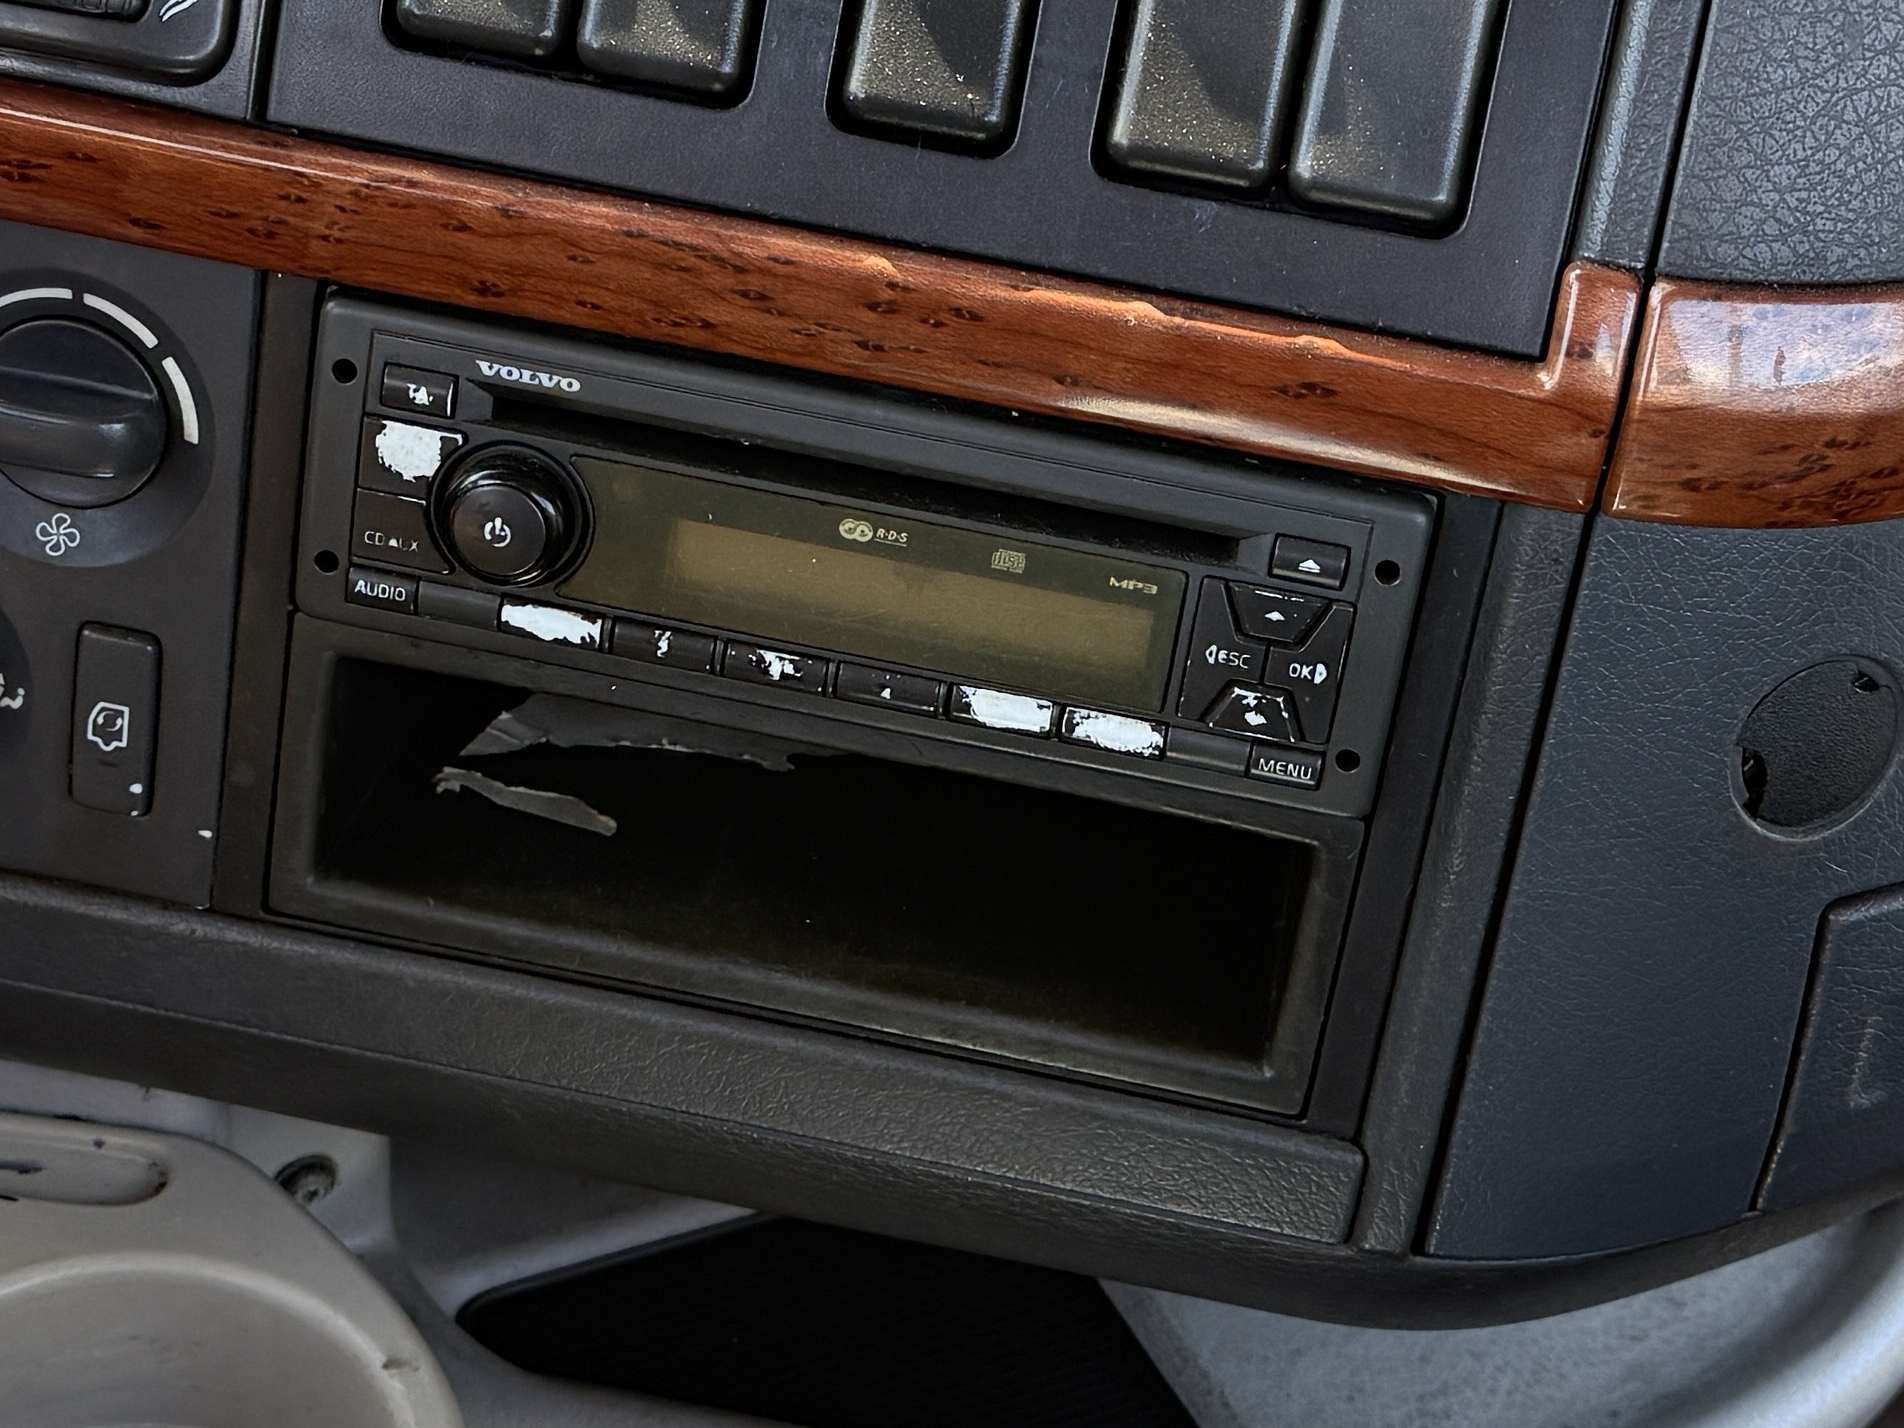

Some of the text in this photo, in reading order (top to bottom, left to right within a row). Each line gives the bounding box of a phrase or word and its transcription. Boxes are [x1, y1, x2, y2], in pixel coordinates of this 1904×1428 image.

[475, 359, 582, 393] VOLVO
[364, 530, 385, 547] CD
[354, 578, 407, 602] AUDIO
[1108, 575, 1159, 595] MP3
[1217, 649, 1252, 669] ESC
[1288, 662, 1313, 680] OK
[1258, 756, 1313, 780] MENU
